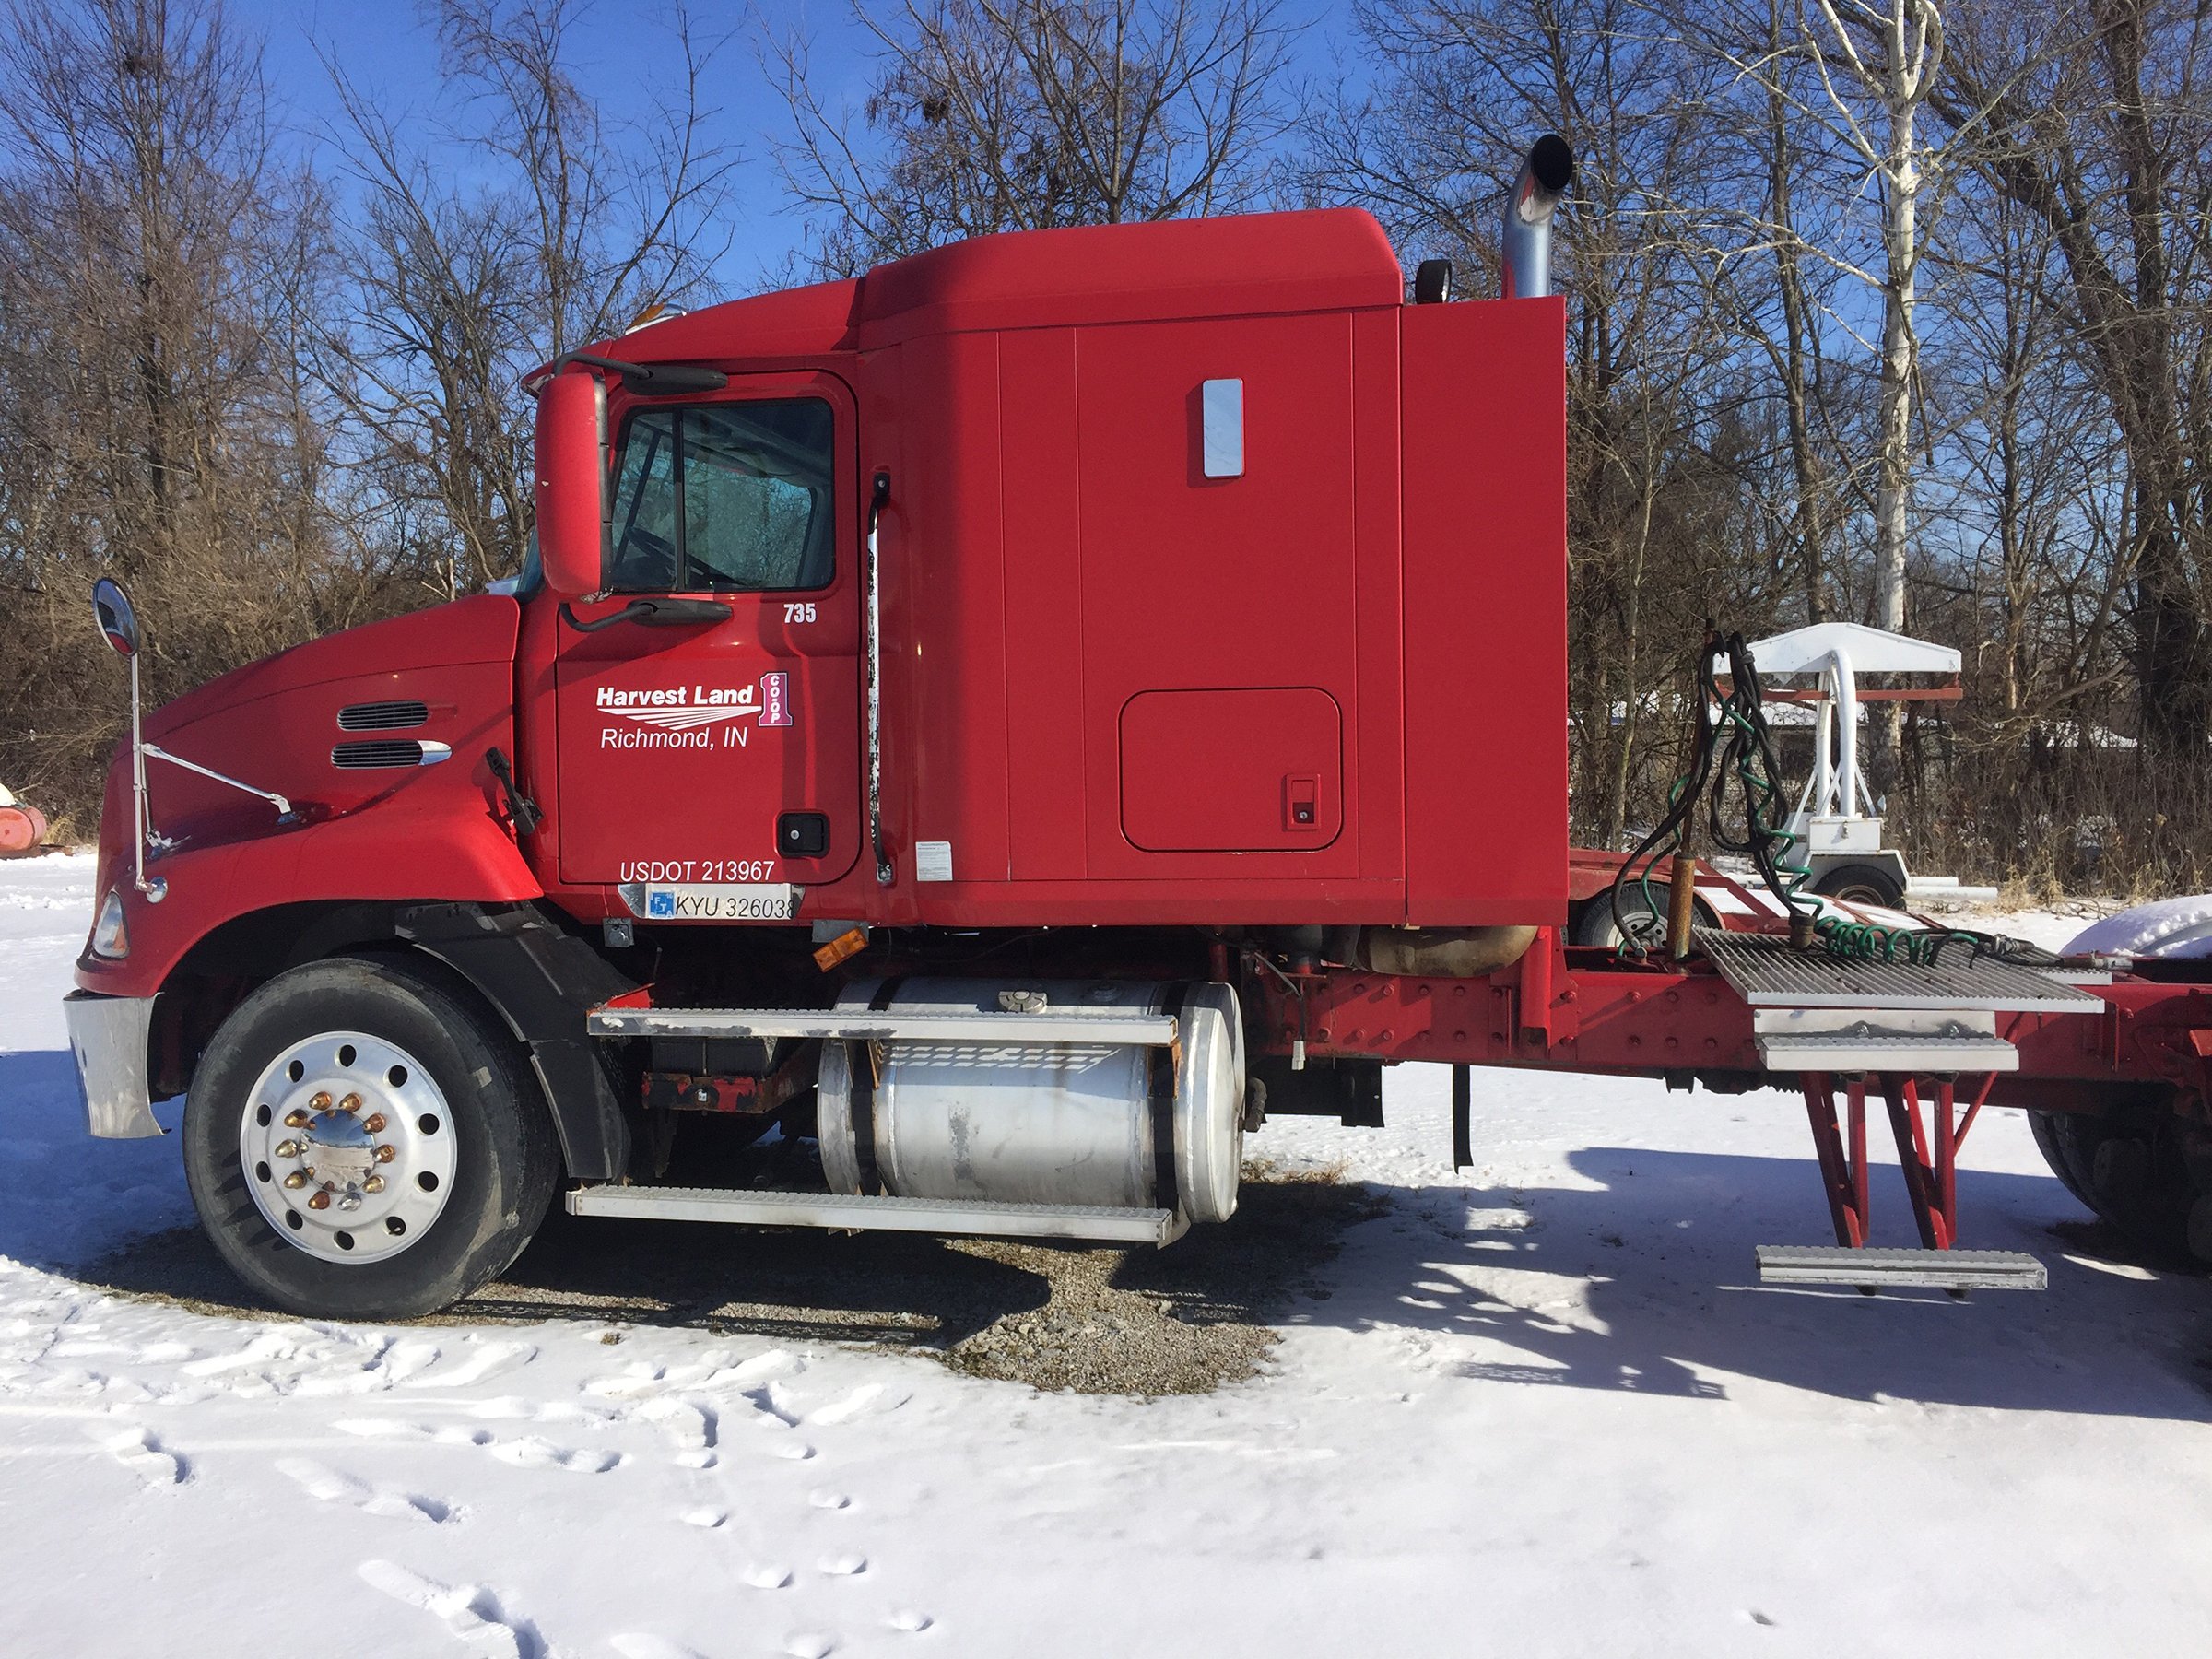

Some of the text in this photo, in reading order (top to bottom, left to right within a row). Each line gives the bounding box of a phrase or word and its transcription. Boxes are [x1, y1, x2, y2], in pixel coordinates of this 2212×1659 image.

[783, 603, 817, 624] 735
[596, 685, 754, 706] Harvest Land
[770, 675, 781, 724] CO-OP
[600, 726, 748, 751] Richmond, IN
[620, 860, 775, 882] USDOT 213967
[676, 896, 720, 916] KYU
